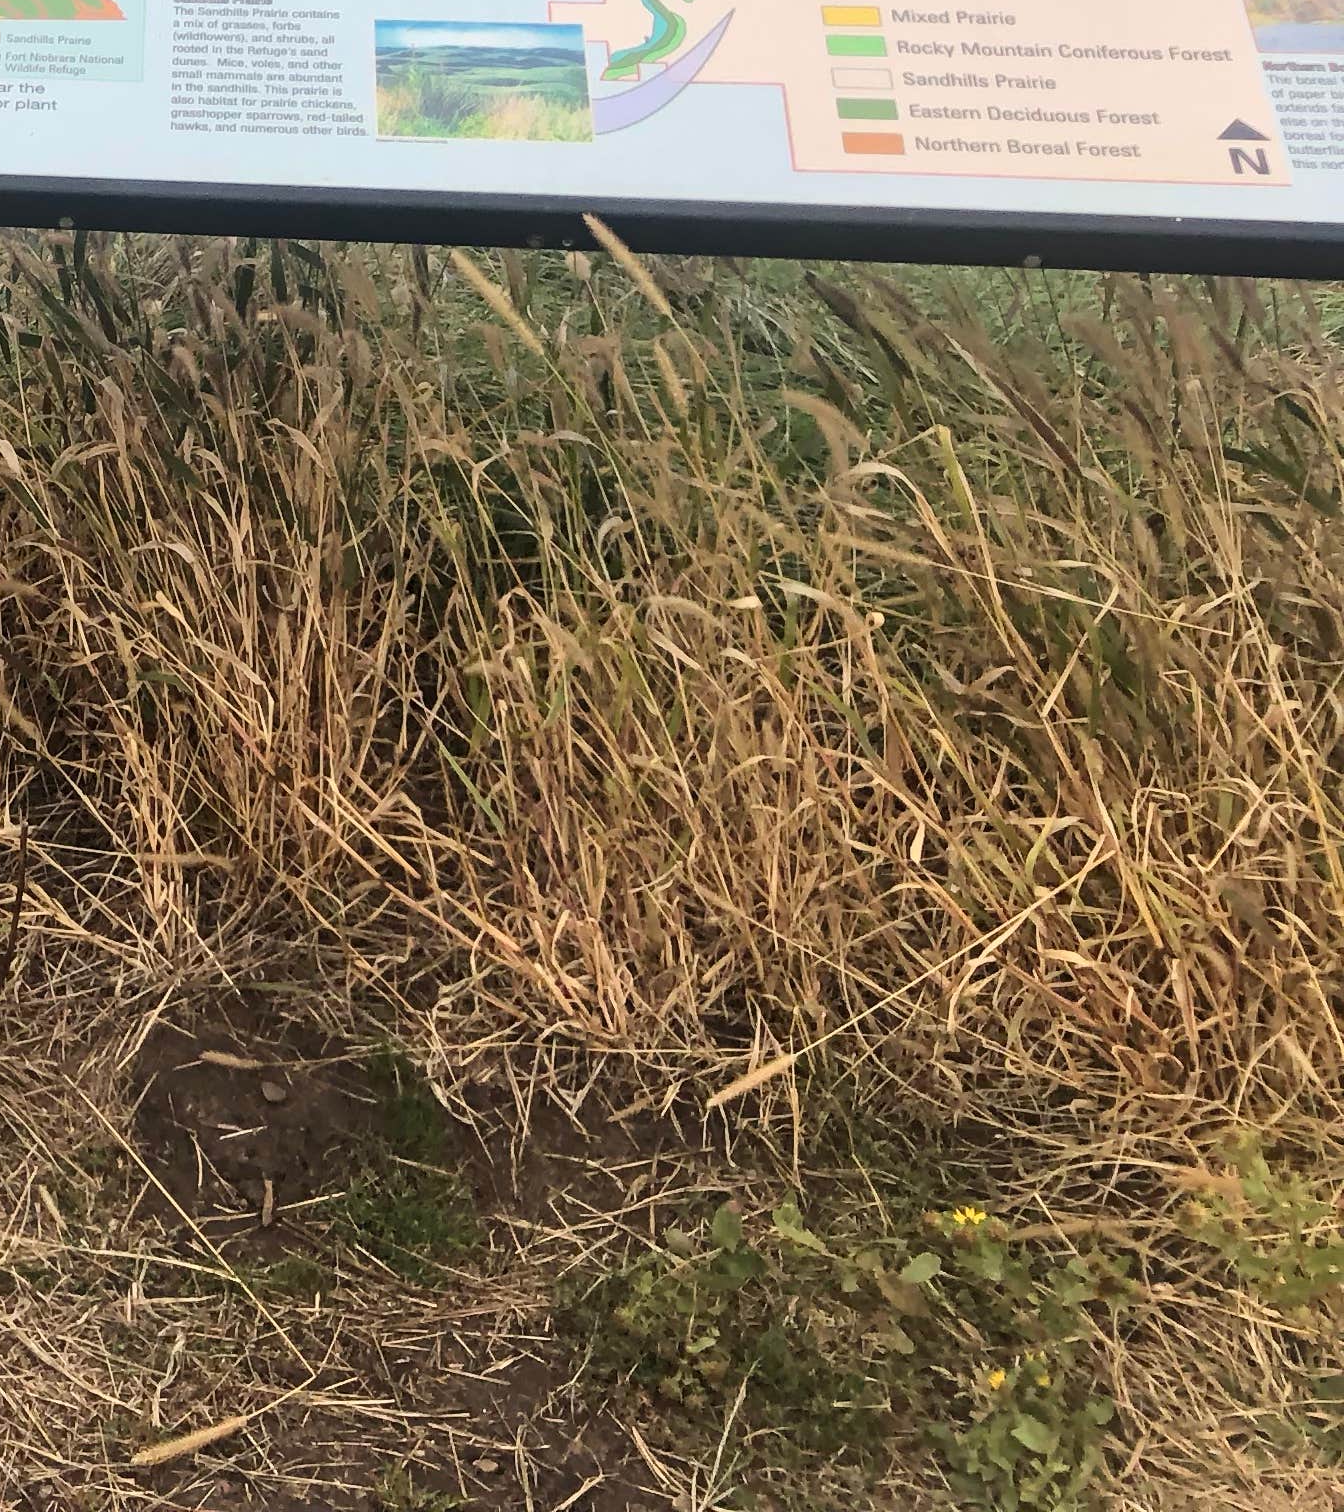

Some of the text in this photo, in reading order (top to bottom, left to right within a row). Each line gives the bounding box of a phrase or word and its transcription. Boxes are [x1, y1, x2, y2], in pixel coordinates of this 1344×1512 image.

[172, 6, 340, 19] The Sandhills Prairie contains
[890, 9, 1016, 26] Mixed Prairie
[6, 33, 92, 46] Sandhills Prairie
[172, 45, 328, 57] rooted in the Refuge's sand
[896, 39, 1233, 62] Rocky Mountain Coniferous Forest
[5, 52, 124, 65] Fort Niobrara National
[4, 62, 88, 76] Wildlife Refuge
[171, 70, 343, 83] small mammals are abundant
[902, 71, 1056, 90] Sandhills Prairie
[18, 82, 46, 94] the
[14, 98, 58, 111] plant
[908, 103, 1161, 125] Eastern Deciduous Forest
[170, 121, 369, 136] hawks, and numerous other birds.
[914, 136, 1142, 158] Northern Boreal Forest
[1228, 147, 1271, 175] N
